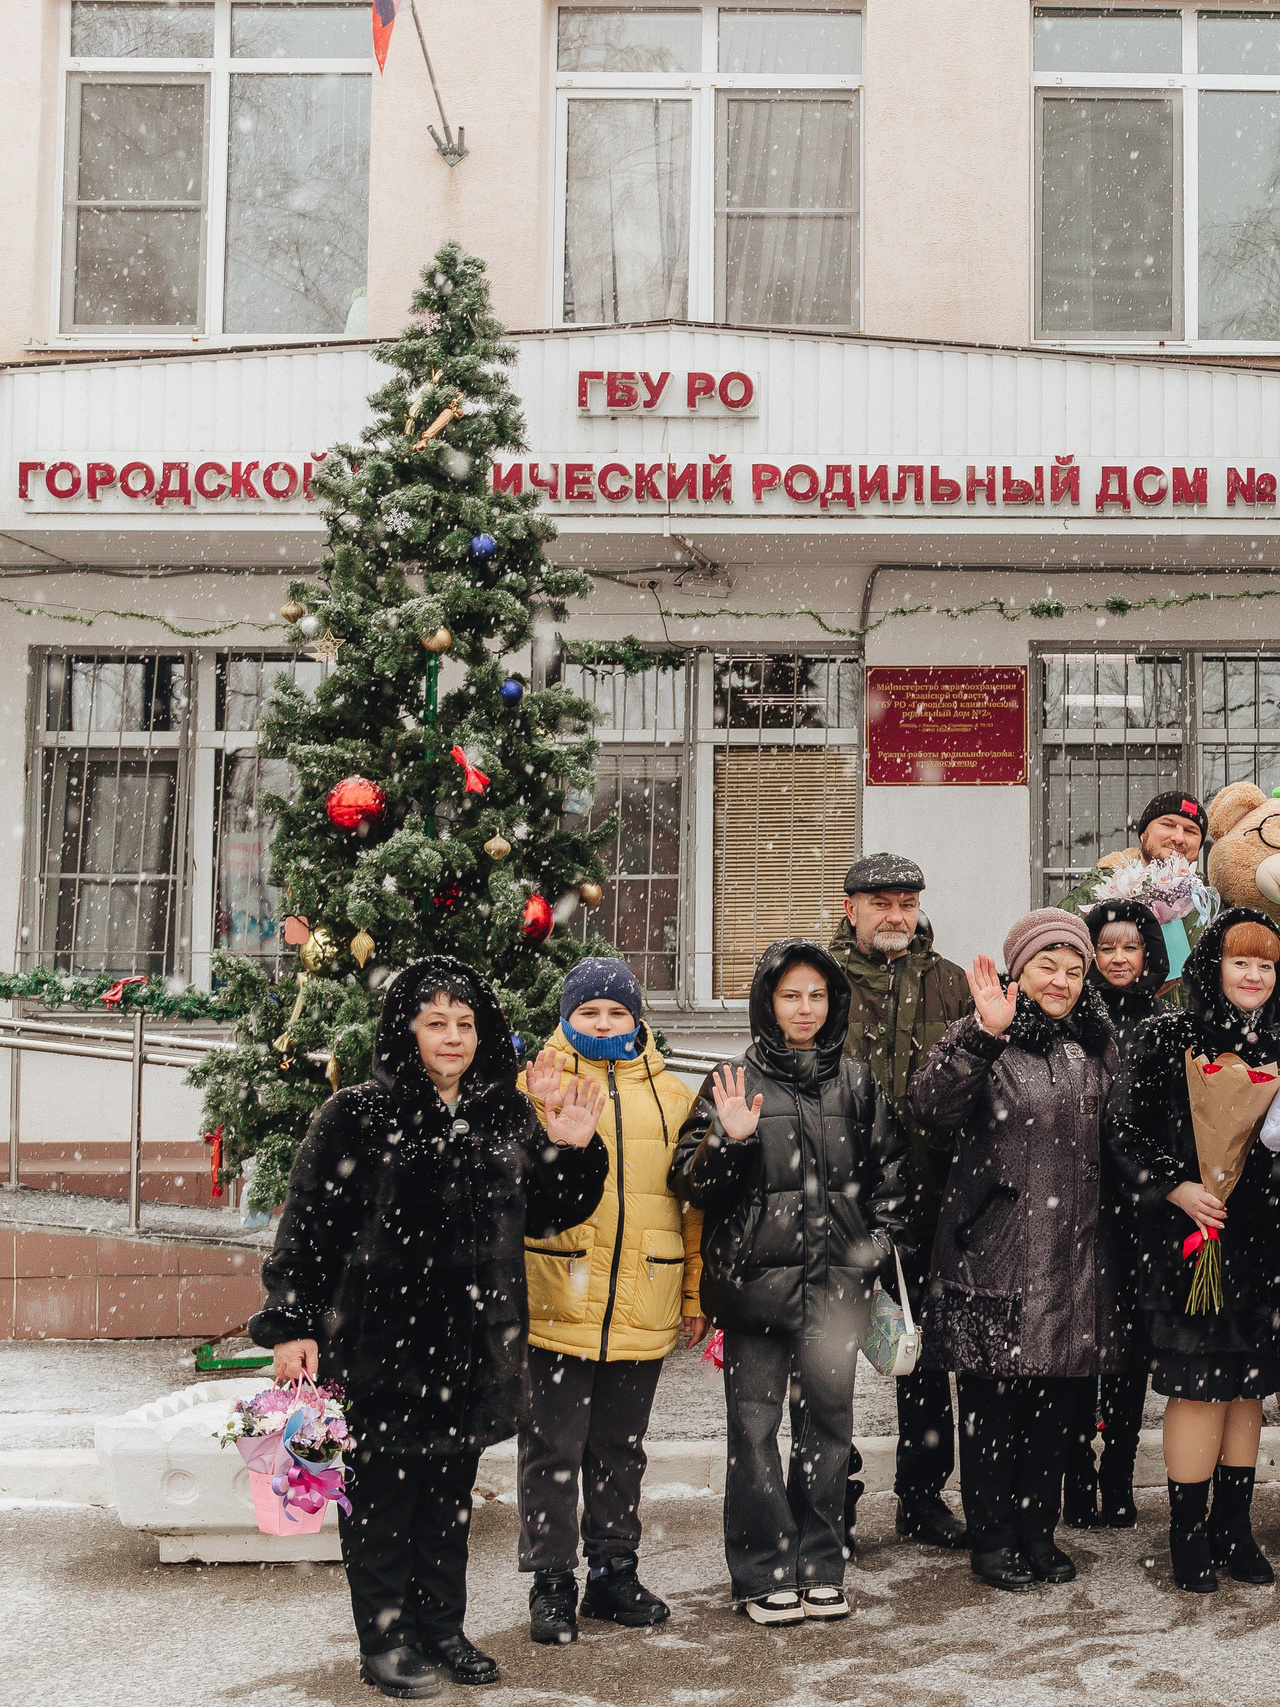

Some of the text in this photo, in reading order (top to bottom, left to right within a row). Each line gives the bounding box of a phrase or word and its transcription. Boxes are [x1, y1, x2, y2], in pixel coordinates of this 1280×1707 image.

[578, 371, 755, 410] ГБУ РО
[492, 453, 734, 502] ИЧЕСКИЙ
[752, 454, 1082, 510] РОДИЛЬНЫЙ
[1096, 466, 1209, 512] ДОМ
[1227, 467, 1277, 505] №
[877, 683, 939, 692] Министерство
[952, 691, 988, 700] обасти
[953, 710, 970, 718] дом
[908, 751, 939, 760] работы
[941, 751, 990, 760] родильного
[916, 760, 978, 768] круглосуточно
